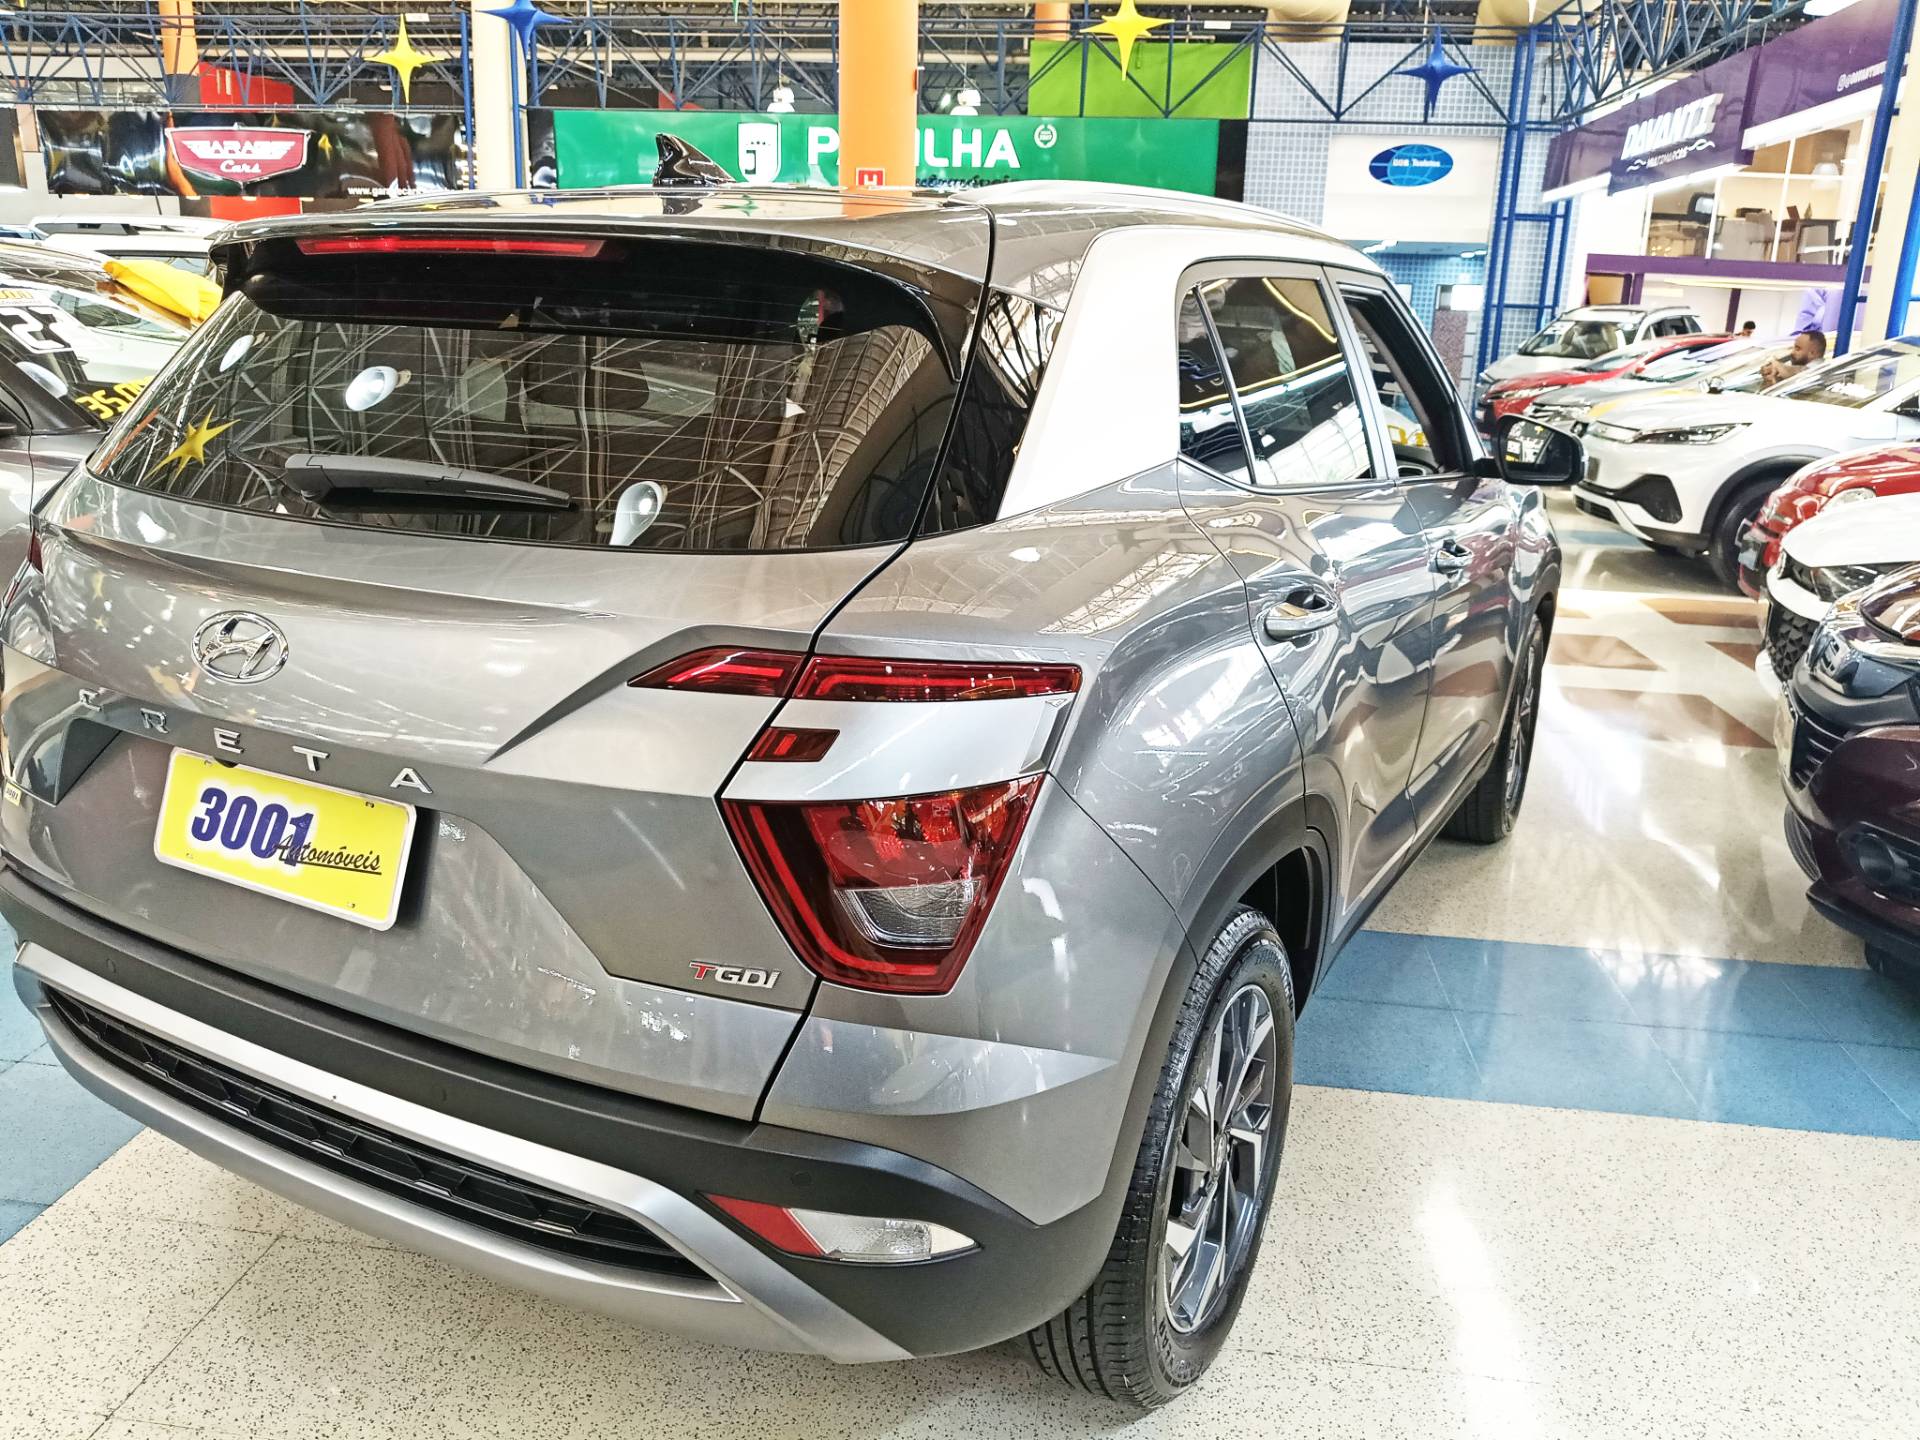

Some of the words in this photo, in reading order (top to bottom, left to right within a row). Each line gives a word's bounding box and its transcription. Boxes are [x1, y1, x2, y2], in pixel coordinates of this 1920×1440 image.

[807, 126, 1021, 168] PLHA
[1621, 93, 1723, 160] DAVANTI
[220, 160, 261, 173] Cars
[79, 689, 433, 794] CRETA
[191, 787, 314, 867] 3001
[276, 834, 382, 872] Automóveis
